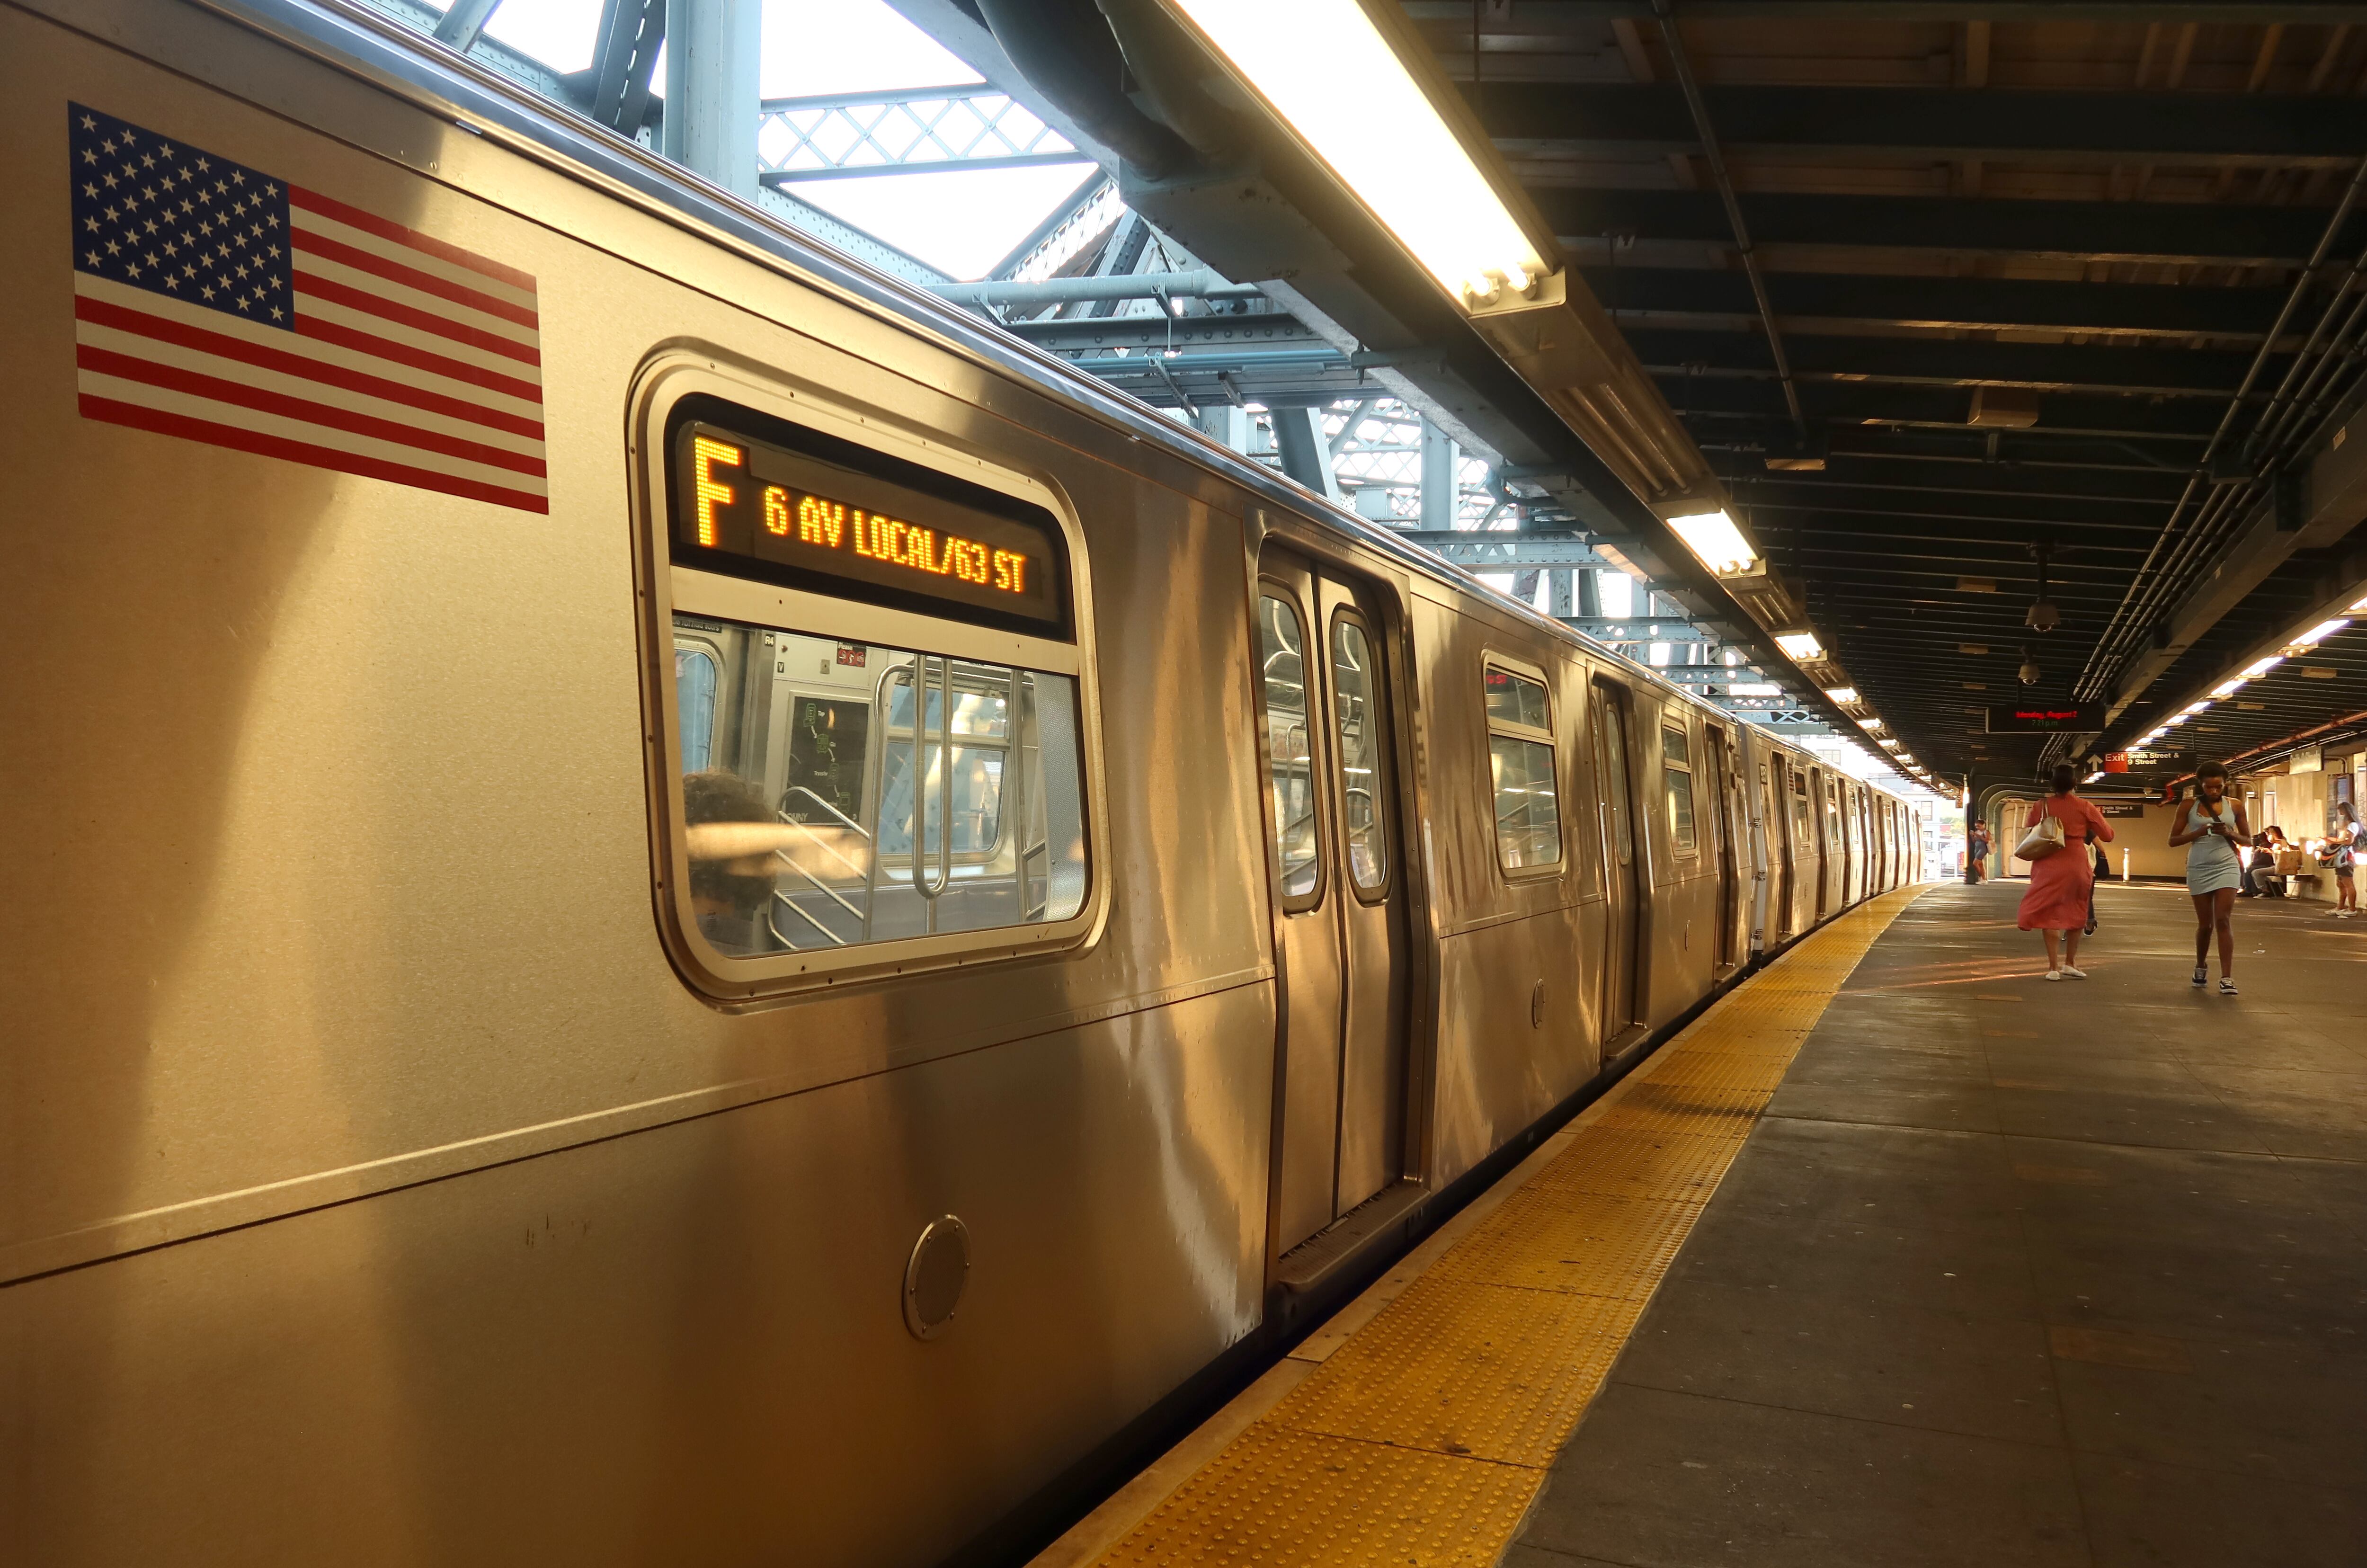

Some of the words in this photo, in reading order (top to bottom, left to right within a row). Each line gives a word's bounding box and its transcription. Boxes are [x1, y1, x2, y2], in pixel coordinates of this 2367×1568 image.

[694, 437, 739, 546] F
[765, 485, 787, 535] 6
[799, 496, 843, 547] AV
[854, 509, 986, 584] LOCAL/63
[994, 549, 1024, 593] ST
[2105, 753, 2125, 762] Exit
